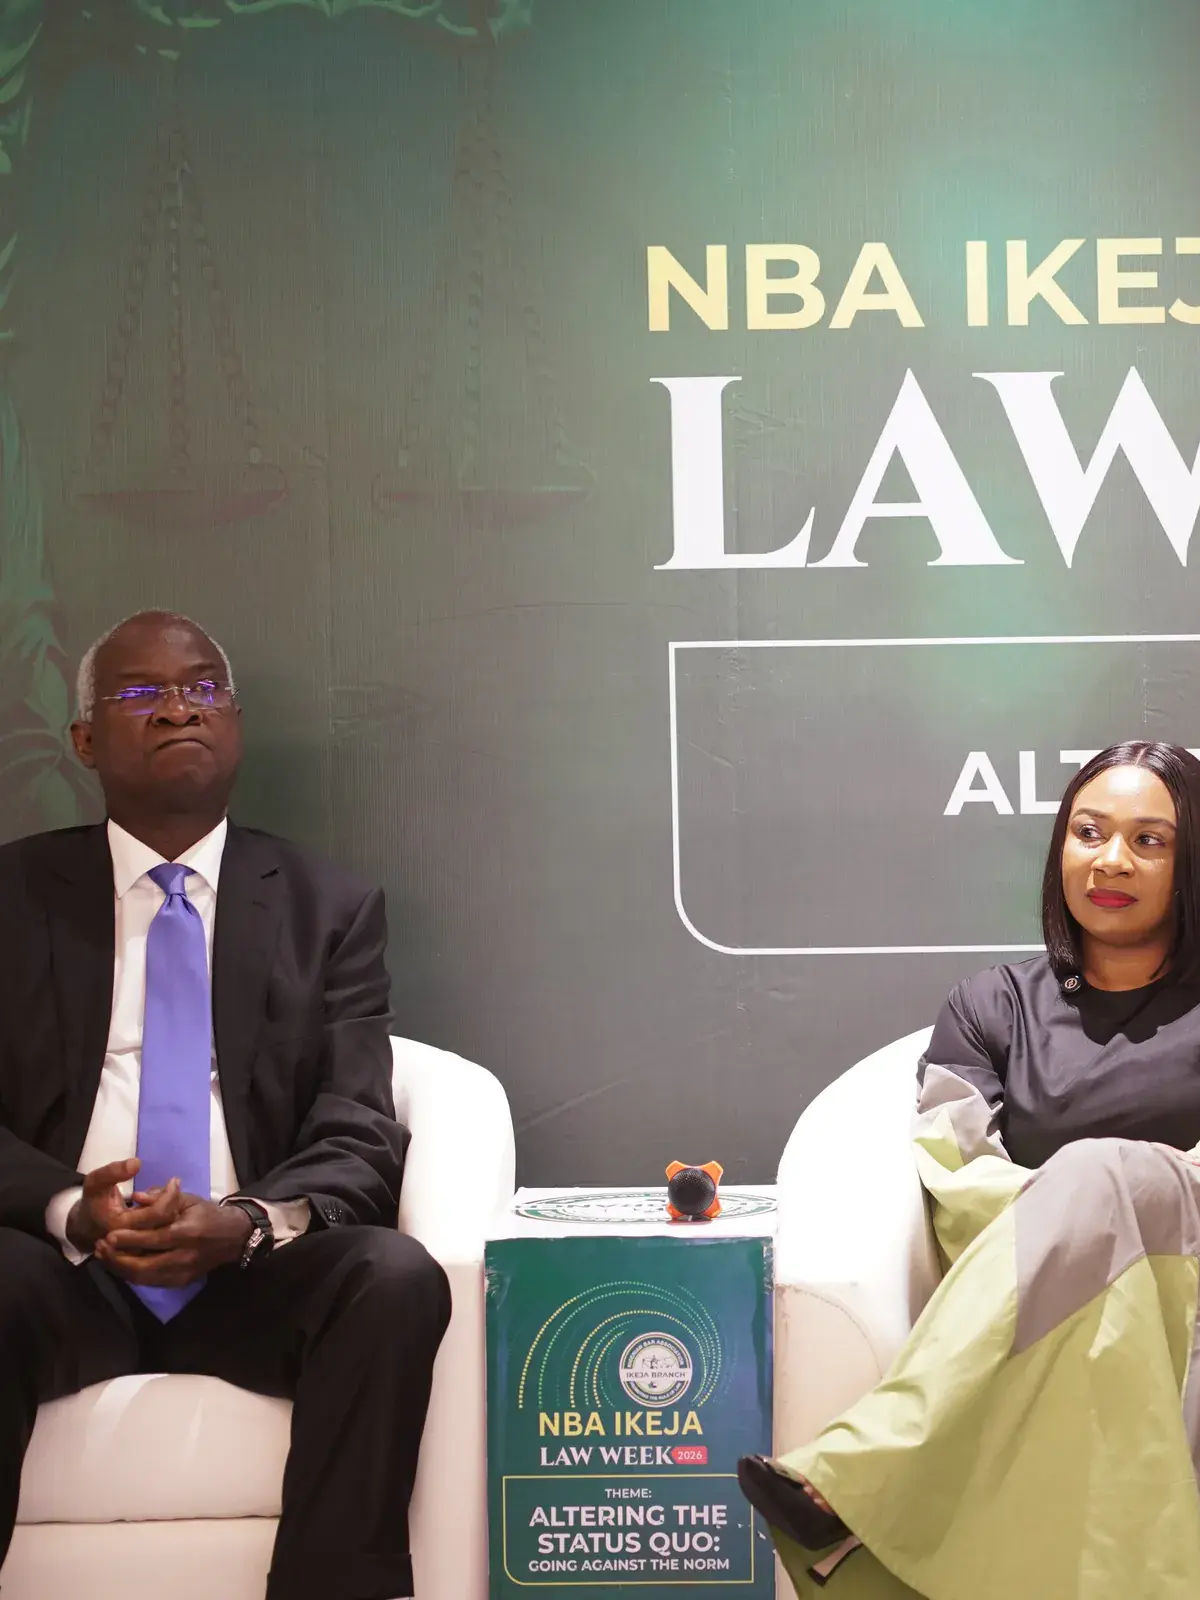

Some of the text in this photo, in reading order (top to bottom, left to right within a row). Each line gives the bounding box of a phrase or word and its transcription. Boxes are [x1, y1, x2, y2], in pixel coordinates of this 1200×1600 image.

[648, 242, 925, 331] NBA
[539, 1411, 703, 1436] NBA IKEJA
[540, 1446, 702, 1466] LAW WEEK 2026
[605, 1488, 652, 1499] THEME:
[529, 1505, 727, 1527] ALTERING THE
[538, 1532, 720, 1556] STATUS QUO:
[528, 1558, 729, 1572] GOING AGAINST THE NORM
